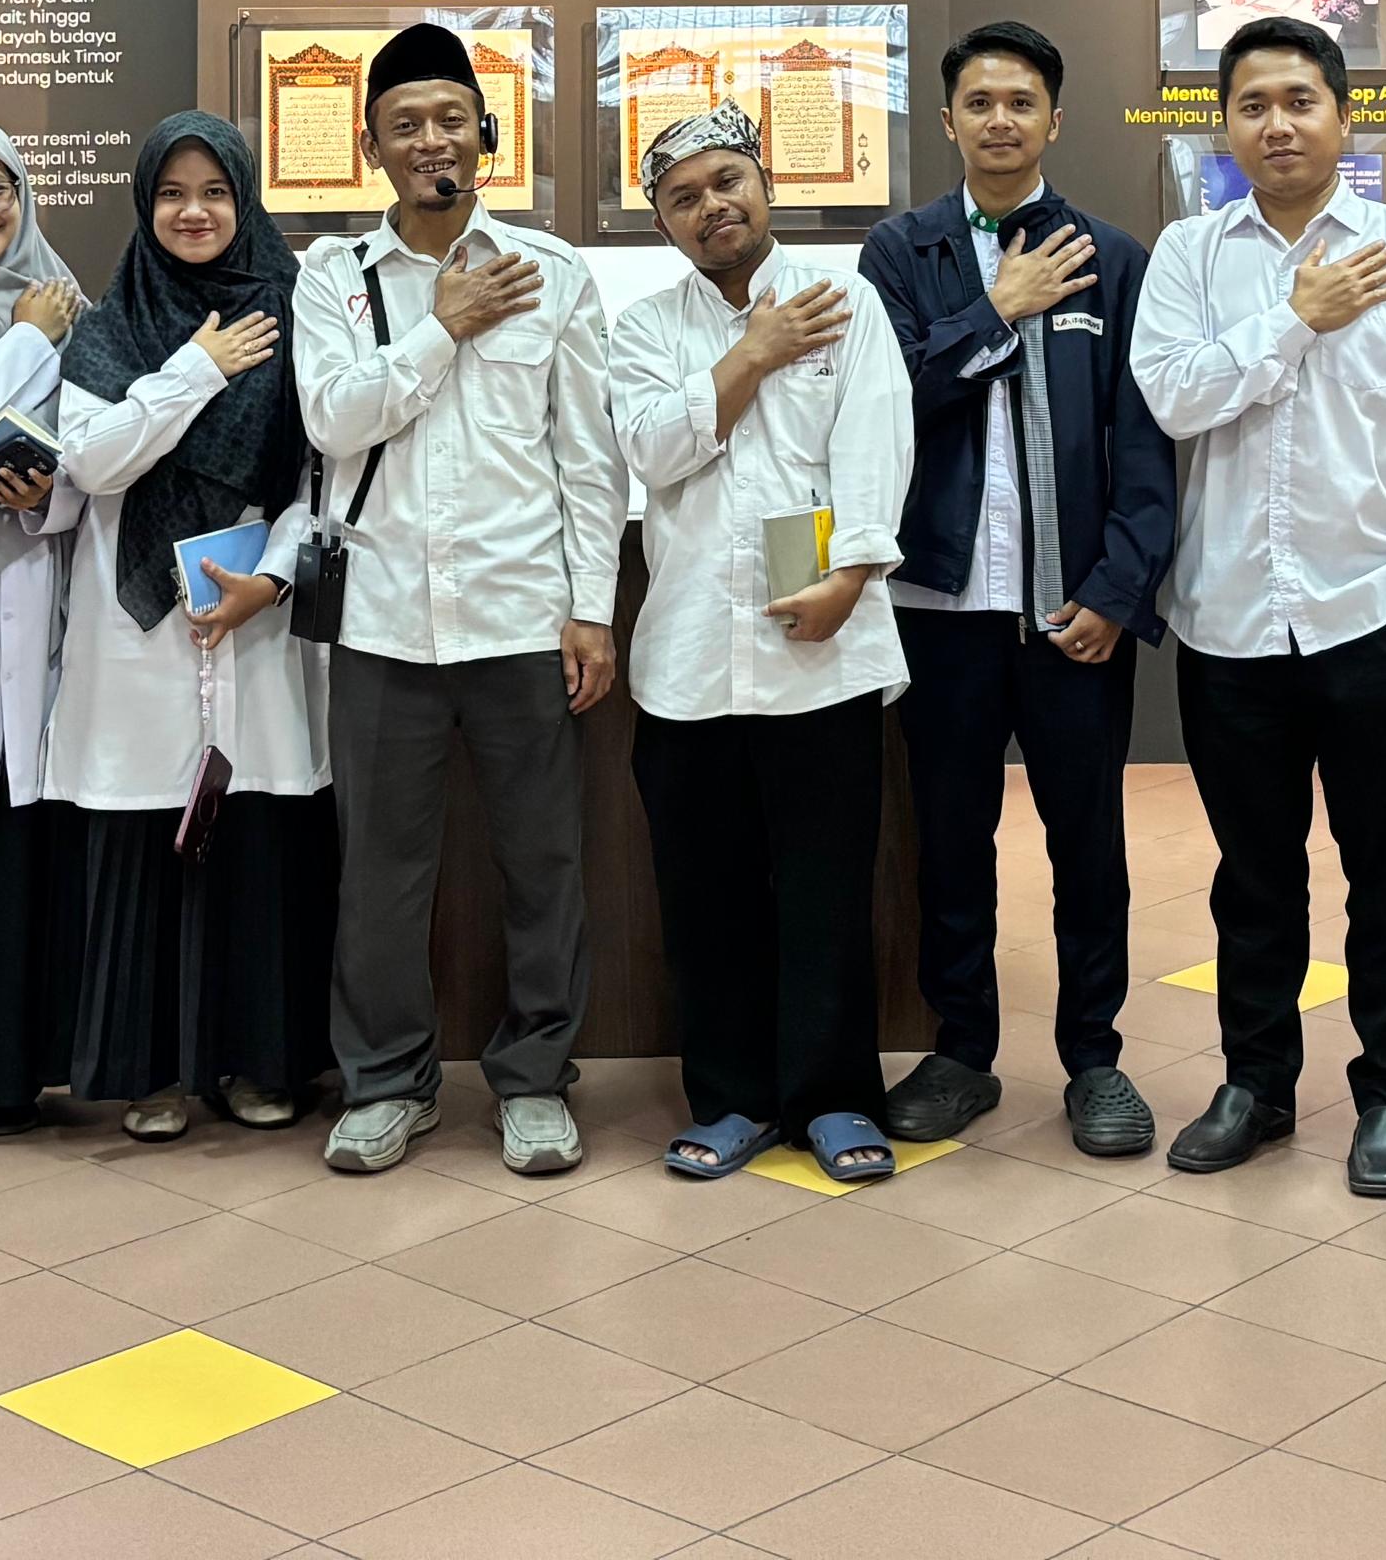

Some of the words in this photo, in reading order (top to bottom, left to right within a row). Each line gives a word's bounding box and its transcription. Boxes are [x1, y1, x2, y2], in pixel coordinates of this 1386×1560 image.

[1162, 87, 1219, 102] Mente
[1124, 108, 1208, 128] Meninjau
[43, 130, 90, 146] resmi
[94, 130, 131, 145] oleh
[80, 150, 97, 164] 15
[65, 170, 131, 185] disusun
